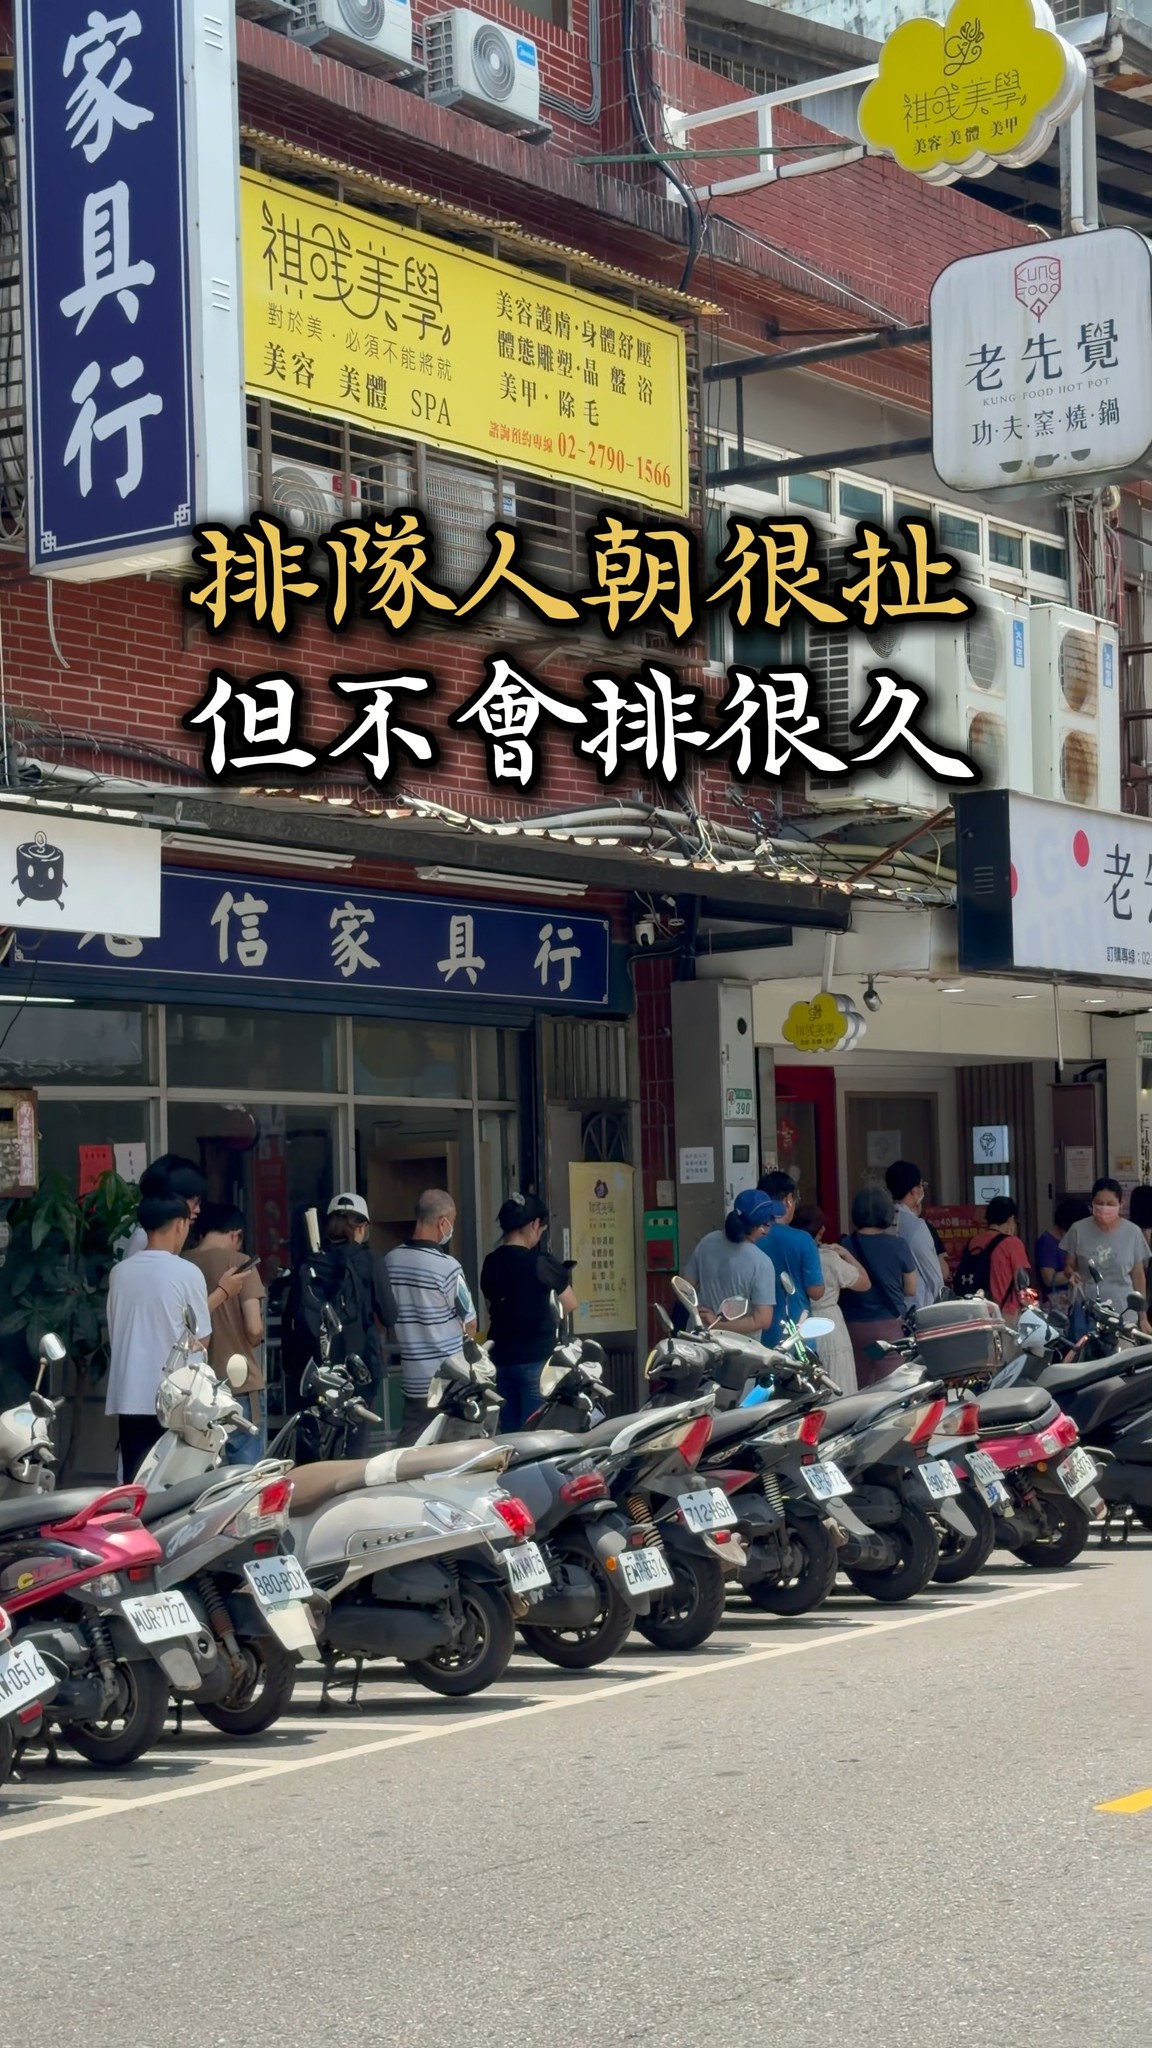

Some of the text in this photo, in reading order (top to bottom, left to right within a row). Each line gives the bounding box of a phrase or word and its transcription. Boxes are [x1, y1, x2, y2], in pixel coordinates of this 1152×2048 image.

[914, 116, 1018, 156] 美容 美體 美甲
[59, 10, 163, 499] 家具行
[264, 341, 452, 427] 美容 美體 SPA
[964, 318, 1119, 391] 老先覺
[983, 377, 1111, 407] KUNG FOOD HOT POT
[558, 431, 671, 488] 02-2790-1566
[1104, 843, 1152, 925] 老
[735, 1102, 751, 1115] 390
